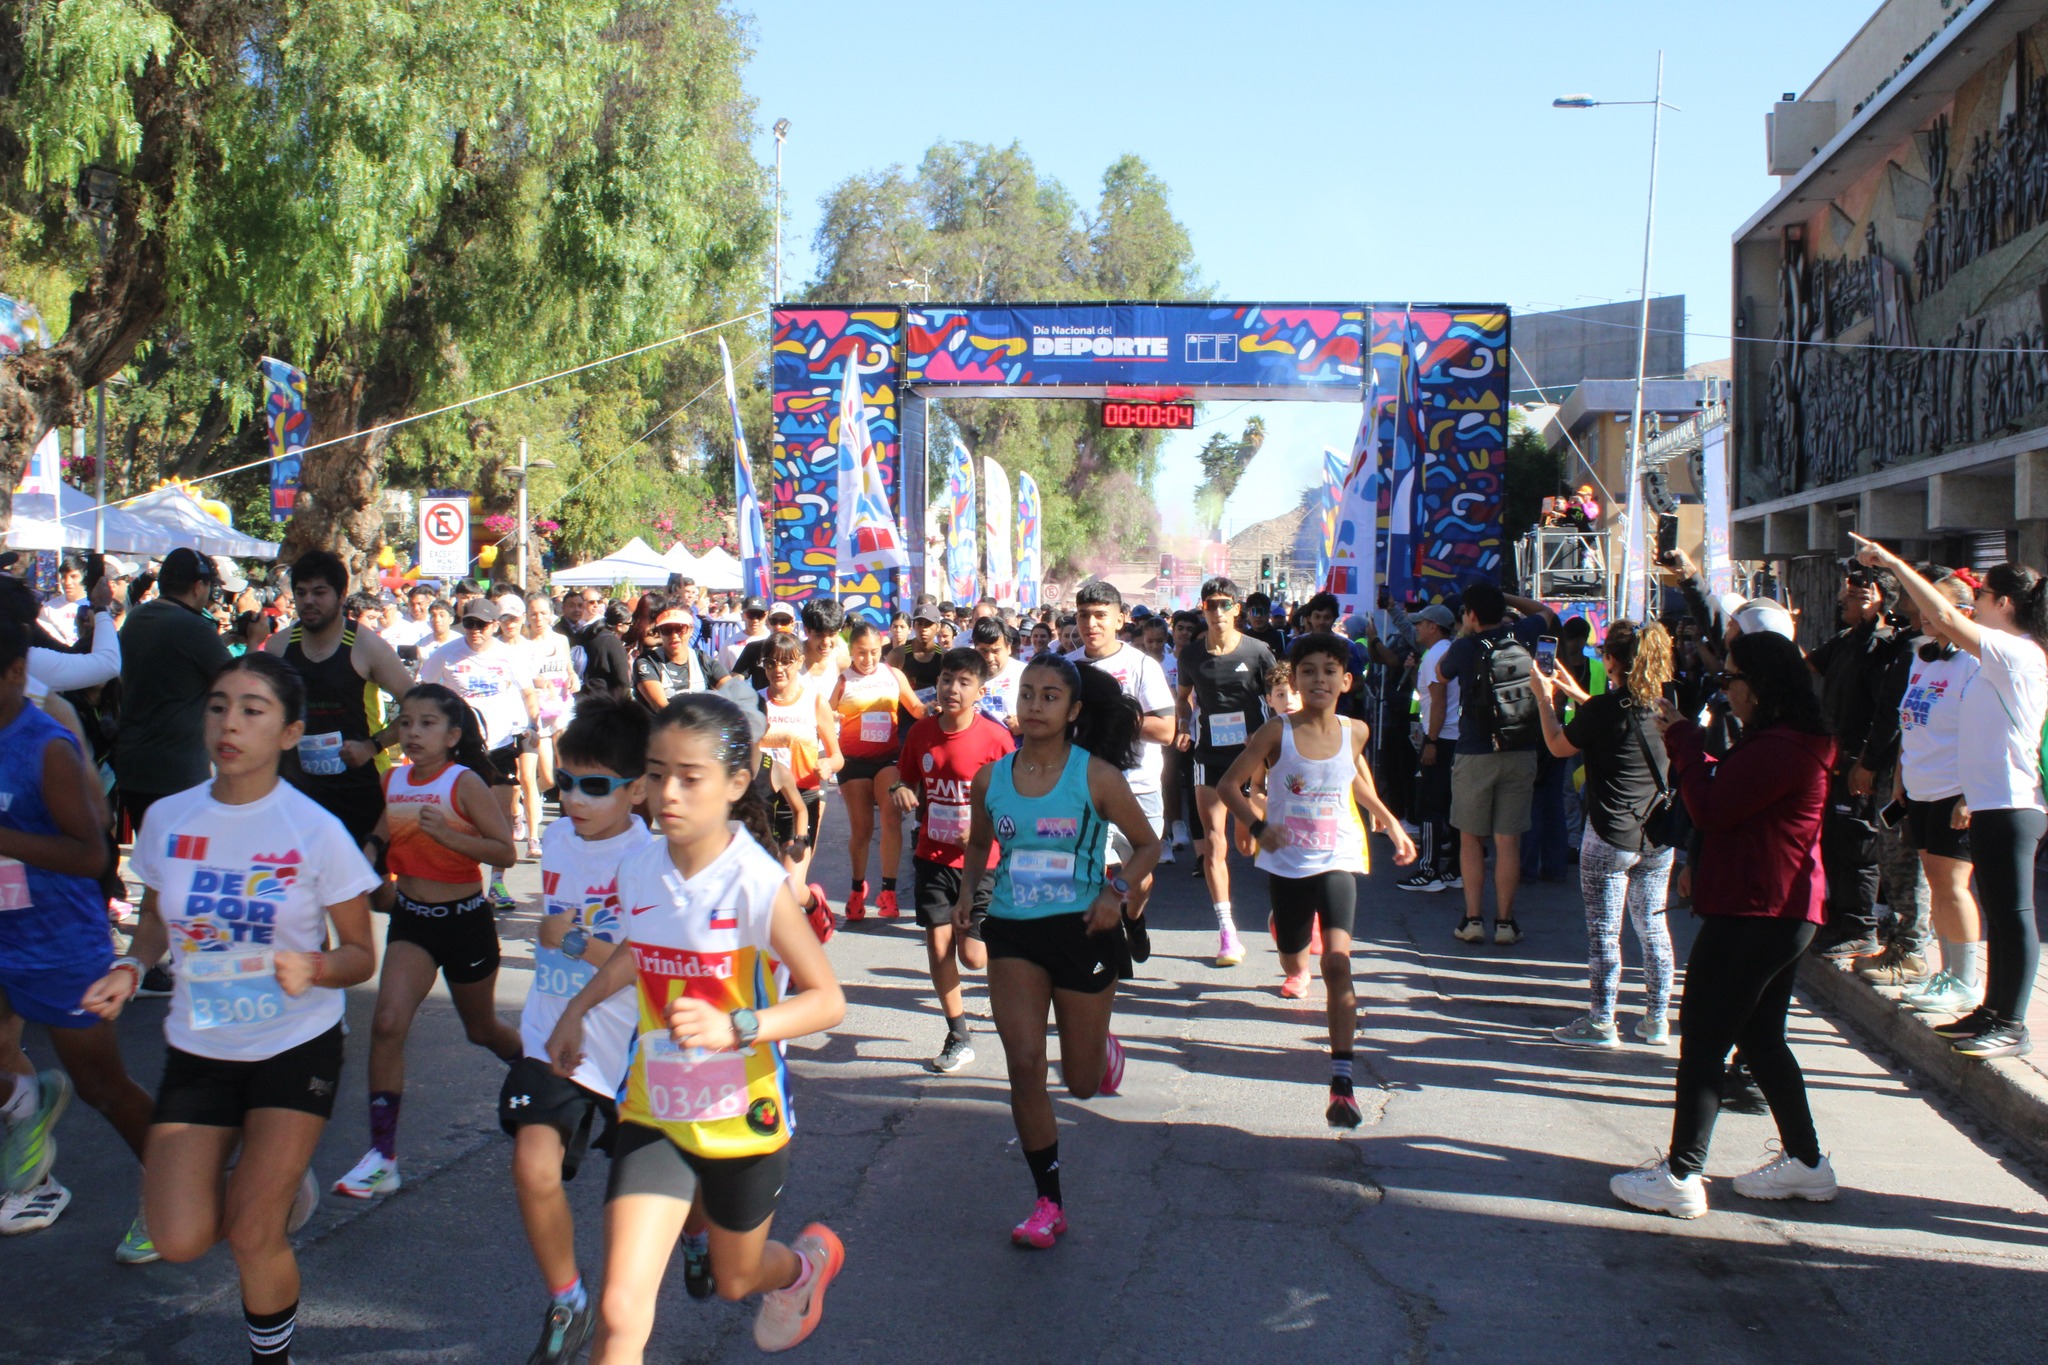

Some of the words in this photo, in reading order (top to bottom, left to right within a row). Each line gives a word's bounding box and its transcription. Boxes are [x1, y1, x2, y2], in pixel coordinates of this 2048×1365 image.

[1033, 326, 1050, 335] Día
[1052, 326, 1095, 335] Nacional
[1097, 326, 1112, 335] del
[1033, 337, 1168, 356] DEPORTE
[1105, 405, 1192, 425] 00:00:04
[1908, 688, 1925, 699] DE
[1904, 699, 1931, 713] POR
[1912, 713, 1928, 725] TE
[1213, 731, 1245, 744] 3433
[303, 760, 341, 773] 3207
[191, 870, 245, 896] DE
[1015, 883, 1071, 904] 3434
[186, 895, 276, 924] POR
[406, 901, 449, 917] PRO
[230, 922, 275, 944] TE
[632, 947, 733, 979] Trinidad
[195, 993, 278, 1025] 3306
[650, 1083, 741, 1118] 0348
